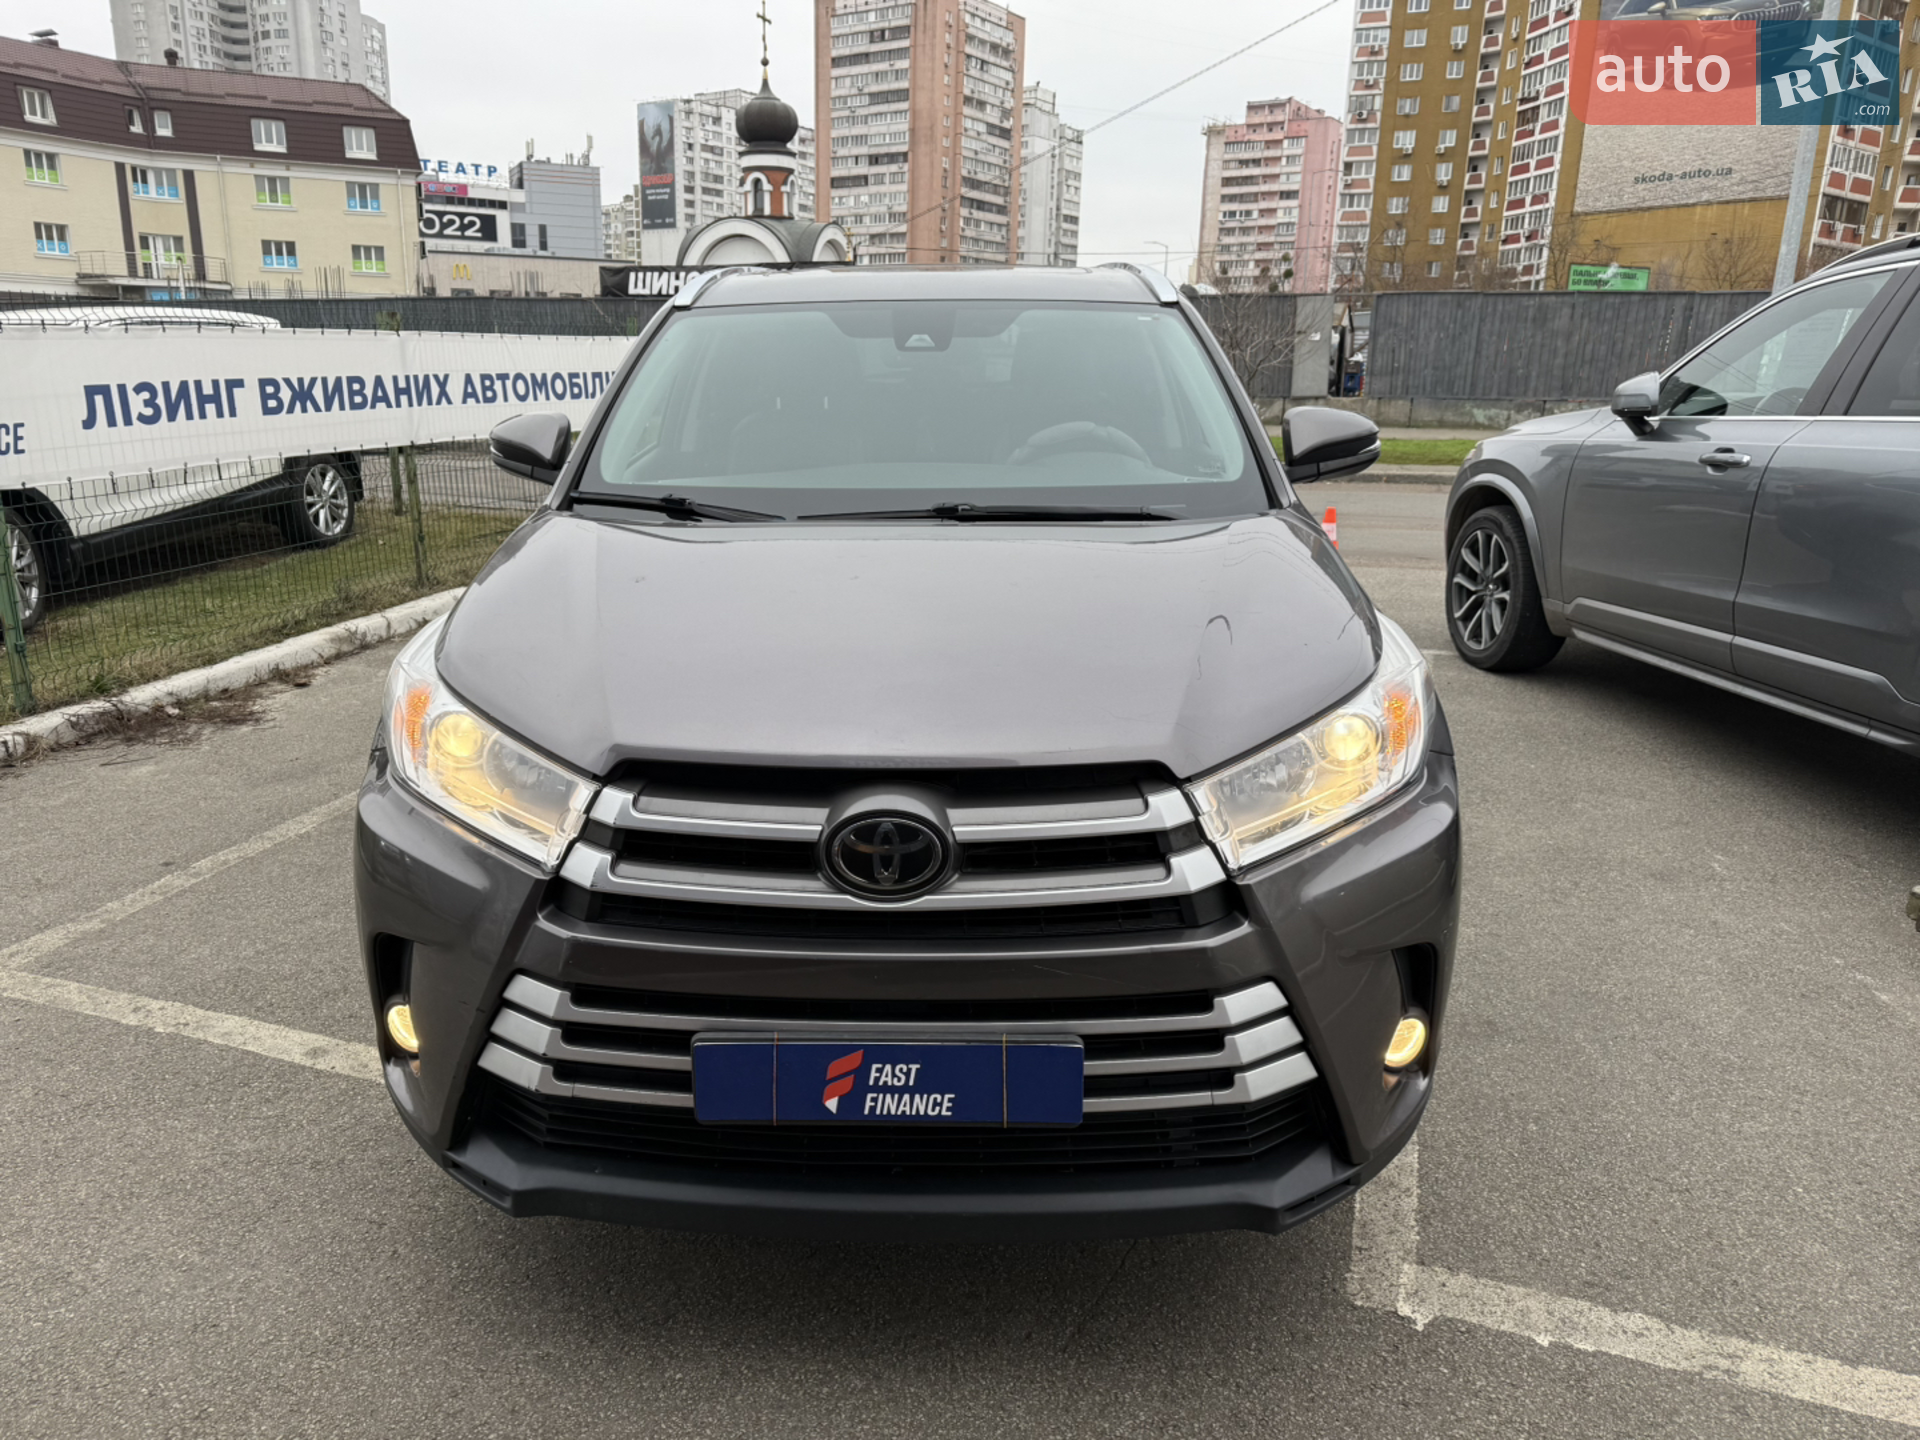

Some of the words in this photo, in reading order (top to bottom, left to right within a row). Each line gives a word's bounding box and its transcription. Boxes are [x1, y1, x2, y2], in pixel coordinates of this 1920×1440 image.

[420, 159, 498, 178] ТЕАТР
[1634, 167, 1733, 184] skoda-auto.ua
[82, 378, 245, 430] ЛІЗИНГ
[257, 373, 454, 416] ВЖИВАНИХ
[868, 1063, 921, 1087] FAST
[863, 1093, 955, 1117] FINANCE
